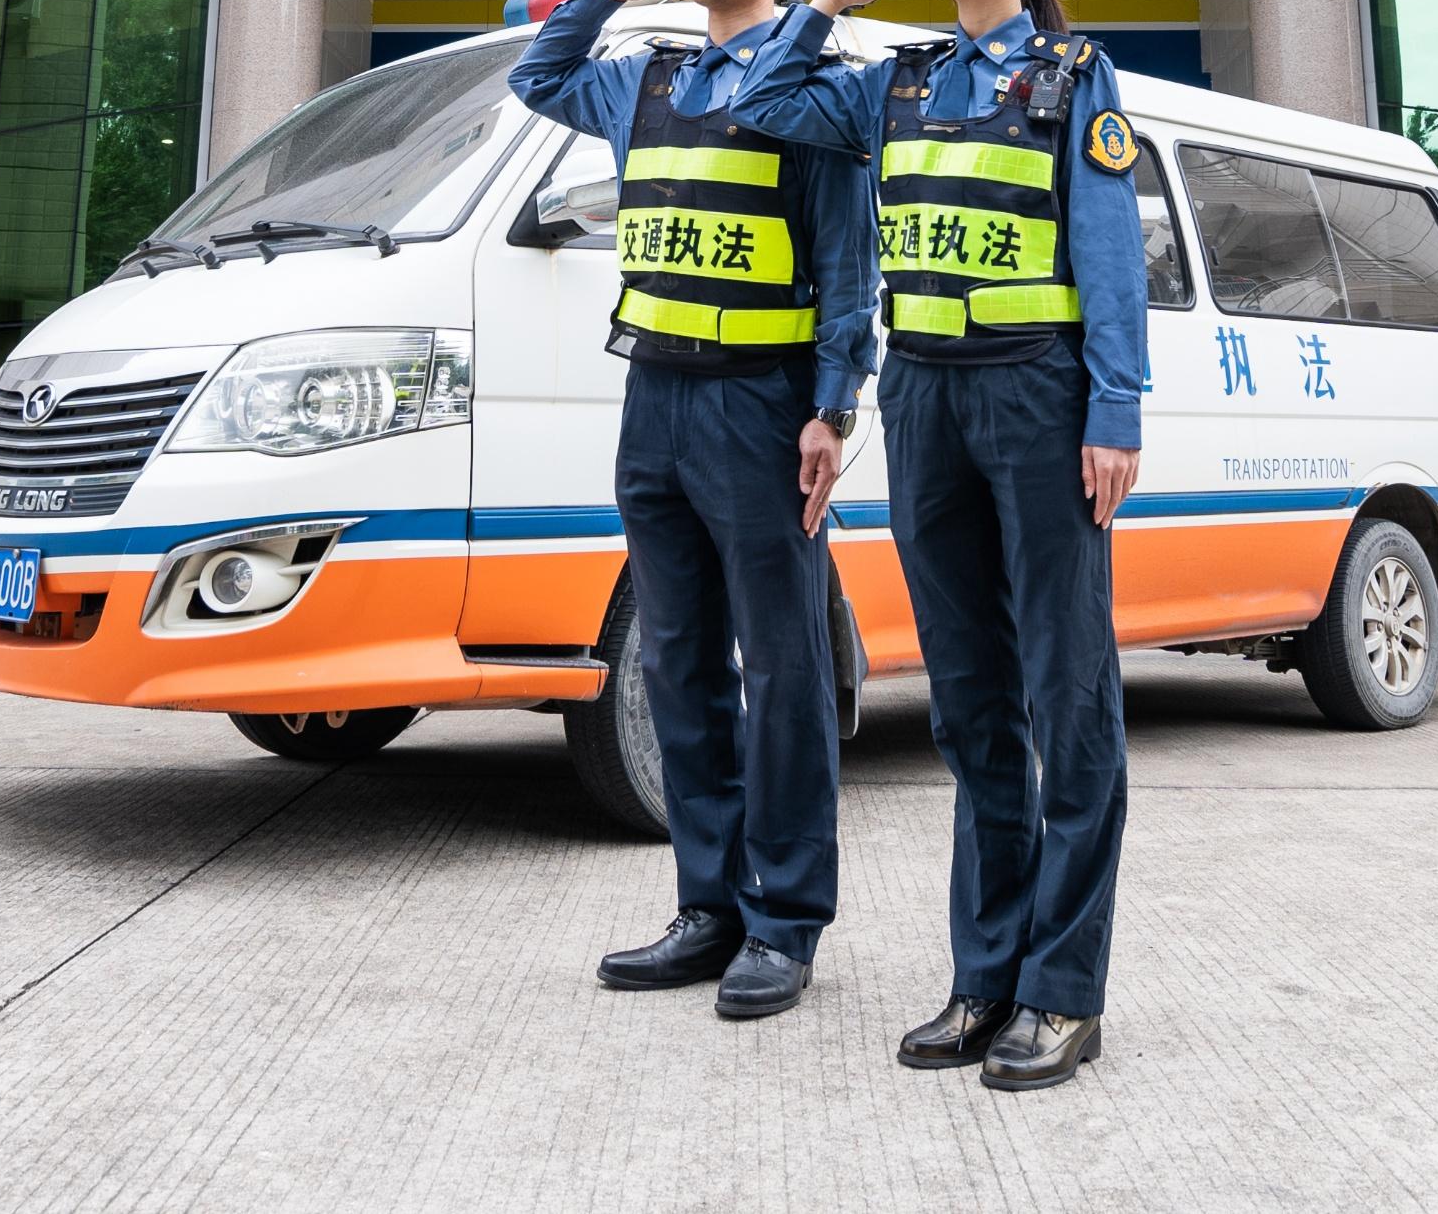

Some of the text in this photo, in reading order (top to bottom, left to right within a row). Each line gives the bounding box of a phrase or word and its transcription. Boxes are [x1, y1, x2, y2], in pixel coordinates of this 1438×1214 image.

[623, 217, 754, 272] 交通执法
[879, 213, 1021, 271] 交通执法
[1142, 326, 1336, 401] 执法
[1222, 457, 1349, 481] TRANSPORTATION
[13, 490, 68, 511] LONG
